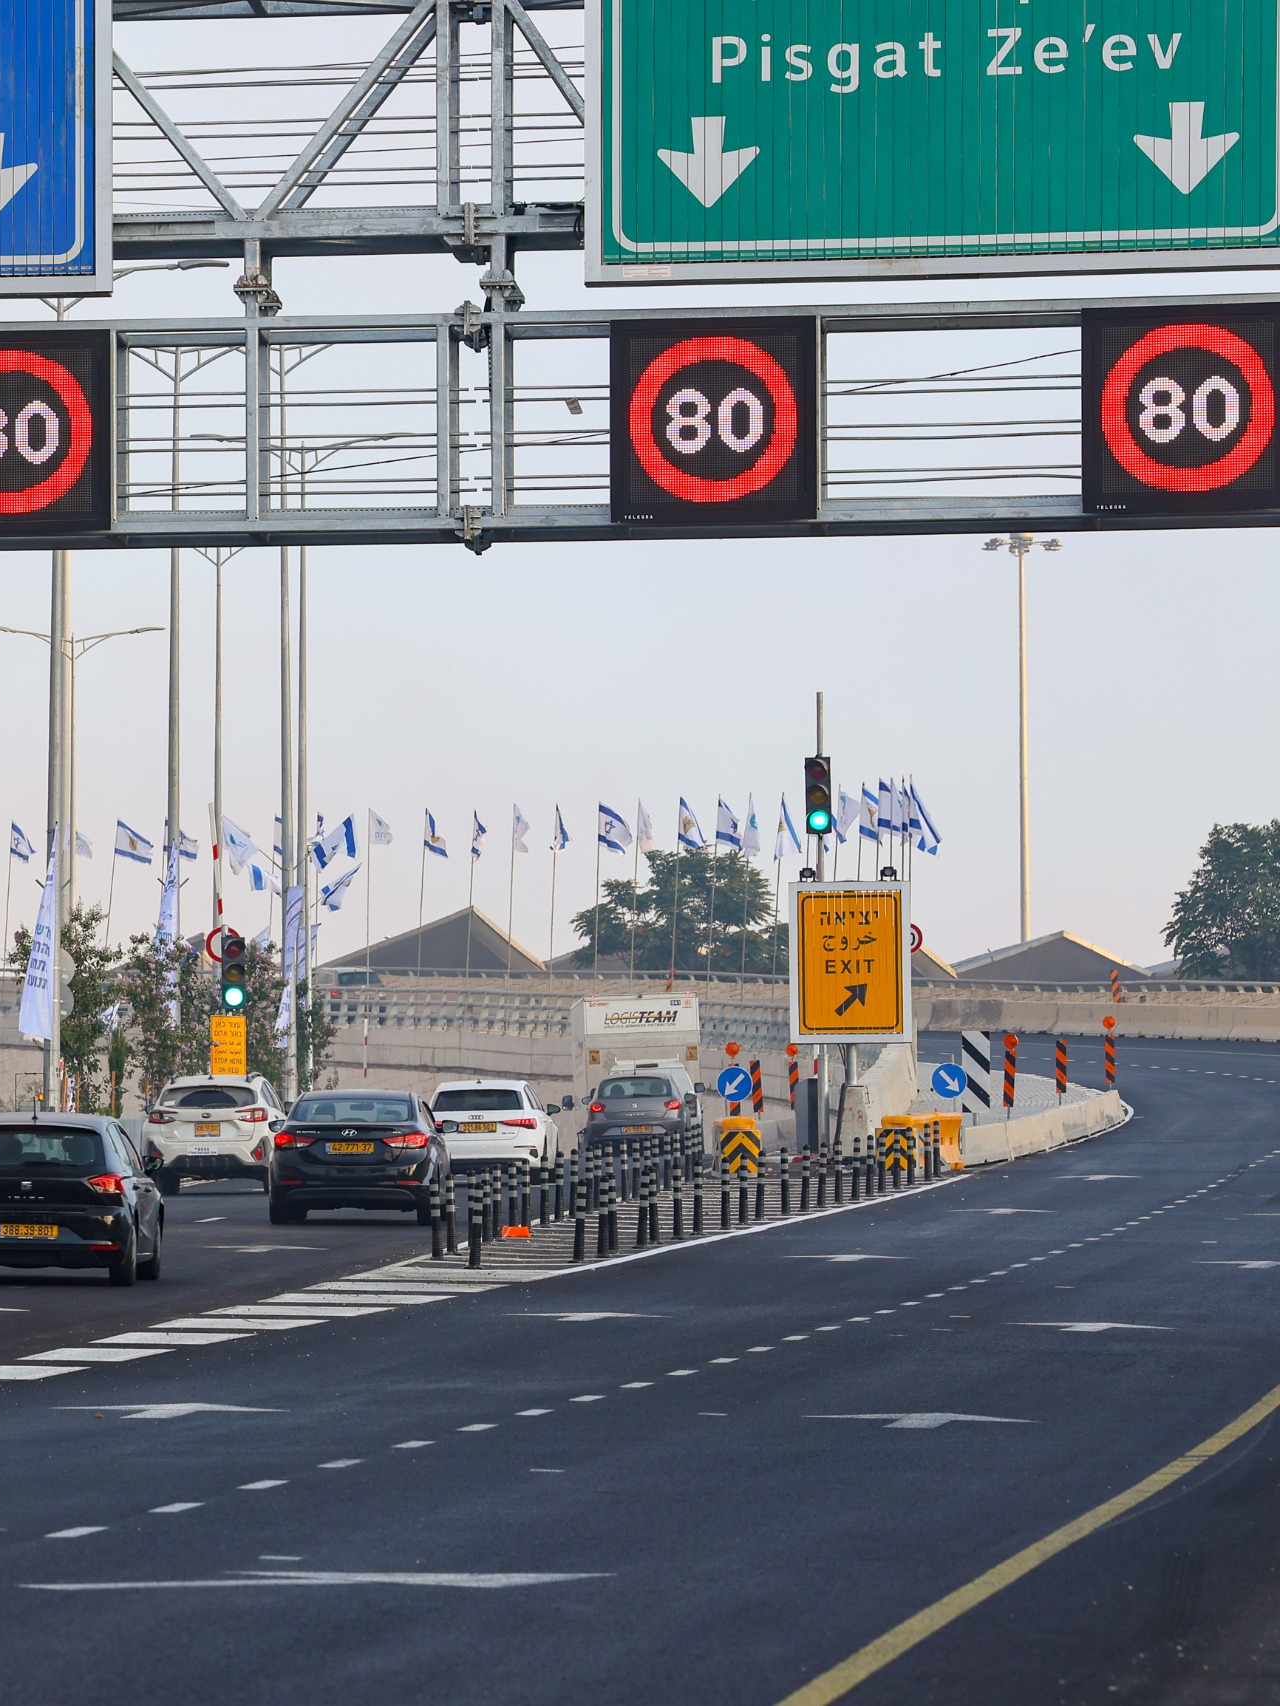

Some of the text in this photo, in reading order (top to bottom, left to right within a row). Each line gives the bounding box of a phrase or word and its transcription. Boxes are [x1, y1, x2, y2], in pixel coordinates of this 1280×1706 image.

[711, 32, 942, 94] Pisgat
[1138, 375, 1240, 444] 80
[665, 388, 764, 454] 80
[820, 911, 879, 926] יציאה
[822, 931, 877, 952] خروج
[825, 959, 875, 975] EXIT
[604, 1010, 678, 1025] LOGISTEAM
